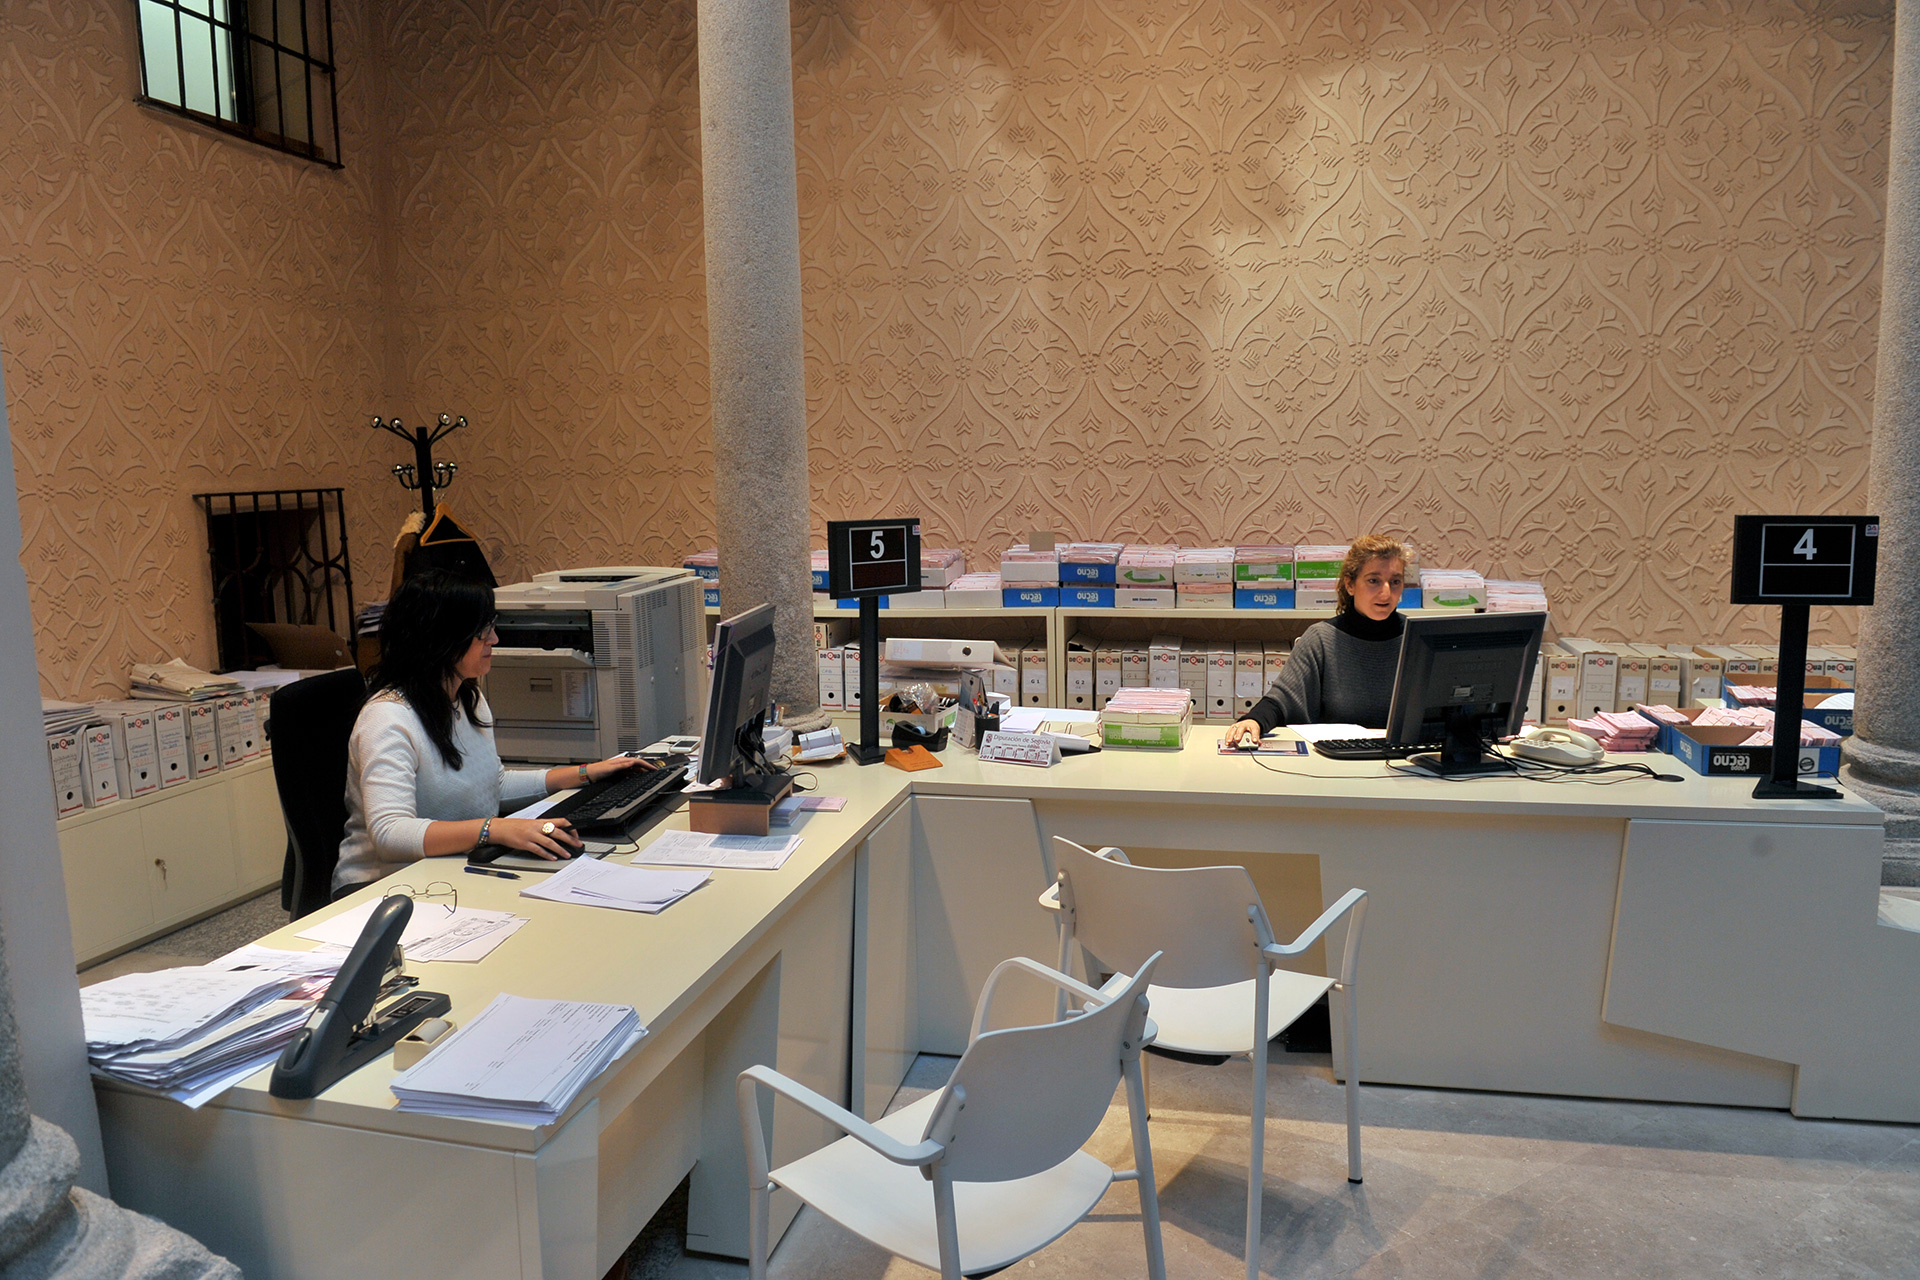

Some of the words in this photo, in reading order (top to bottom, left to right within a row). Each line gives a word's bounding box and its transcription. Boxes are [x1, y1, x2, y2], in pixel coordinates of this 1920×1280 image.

[870, 531, 885, 559] 5
[1793, 528, 1817, 560] 4
[1077, 568, 1099, 578] tecno
[812, 575, 823, 585] tec
[705, 593, 718, 602] tecn
[1021, 593, 1042, 602] tecno
[1077, 592, 1099, 602] tecno
[1253, 594, 1277, 605] tecno
[846, 652, 860, 661] DeQ
[1266, 658, 1285, 667] DeQu
[1804, 662, 1822, 672] Qua
[1763, 663, 1779, 673] DeQ
[1824, 715, 1853, 726] ecno
[993, 734, 1021, 743] Diputación
[1030, 737, 1051, 746] Segovia
[1713, 755, 1750, 770] tecno
